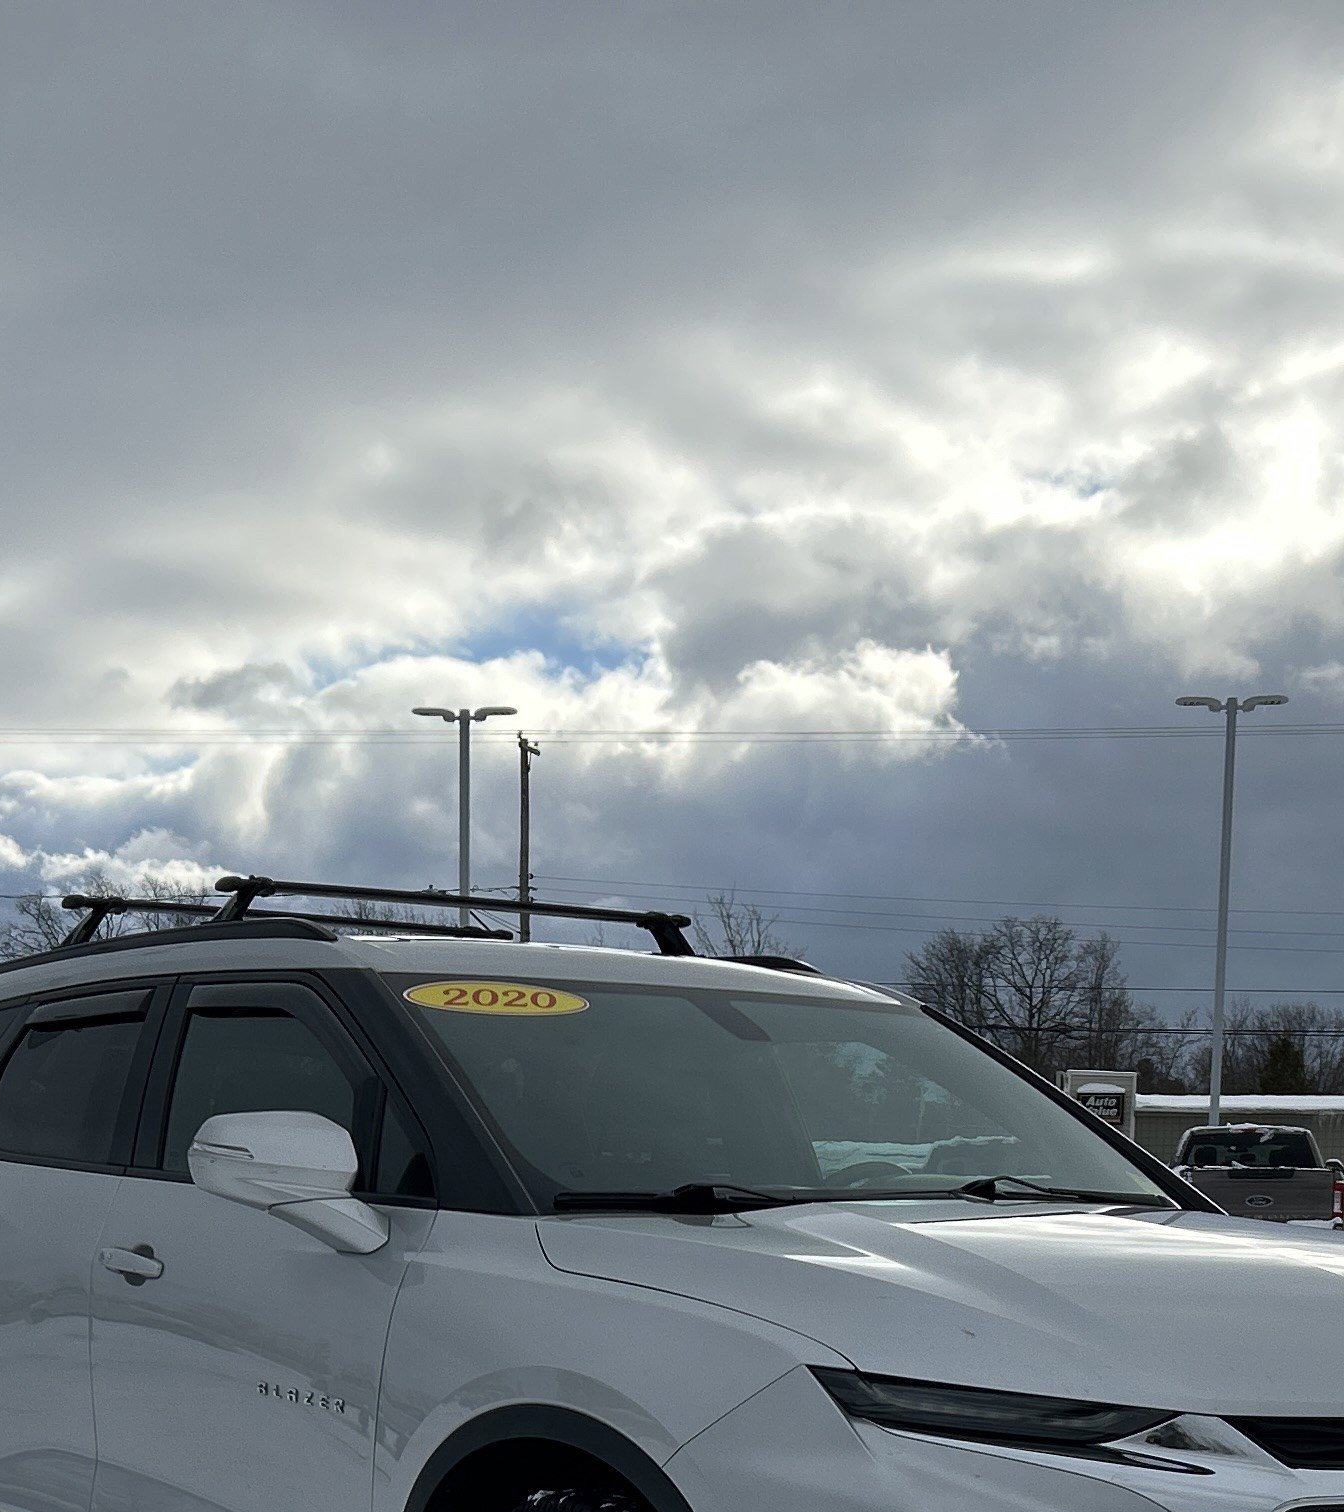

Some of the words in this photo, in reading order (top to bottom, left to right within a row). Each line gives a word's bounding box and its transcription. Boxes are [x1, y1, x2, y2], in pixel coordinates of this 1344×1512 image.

[442, 988, 557, 1009] 2020
[1085, 1096, 1117, 1107] Auto
[1088, 1106, 1118, 1117] alue
[256, 1380, 346, 1415] BLAZER
